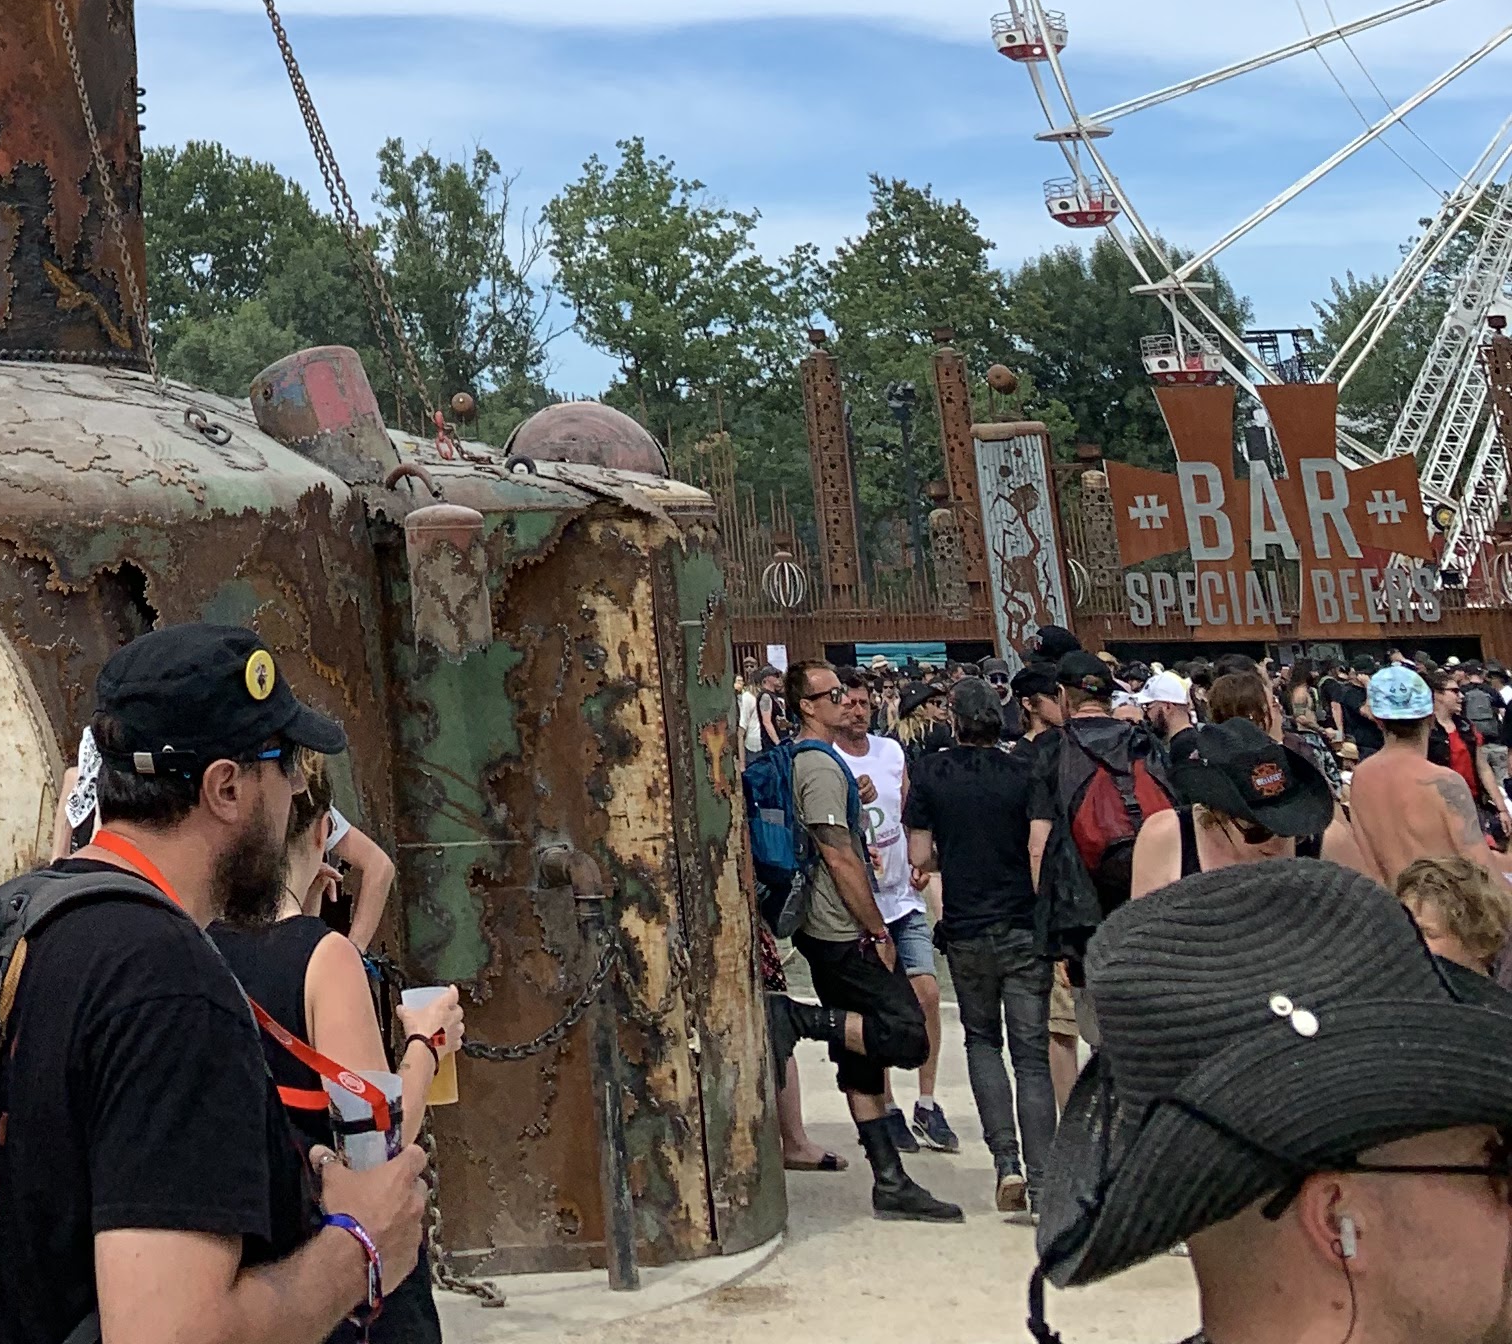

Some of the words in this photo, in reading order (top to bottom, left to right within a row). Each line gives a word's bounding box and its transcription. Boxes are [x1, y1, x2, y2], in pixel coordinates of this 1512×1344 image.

[1176, 457, 1364, 561] BAR
[1124, 570, 1292, 627] SPECIAL
[1310, 567, 1442, 625] BEERS
